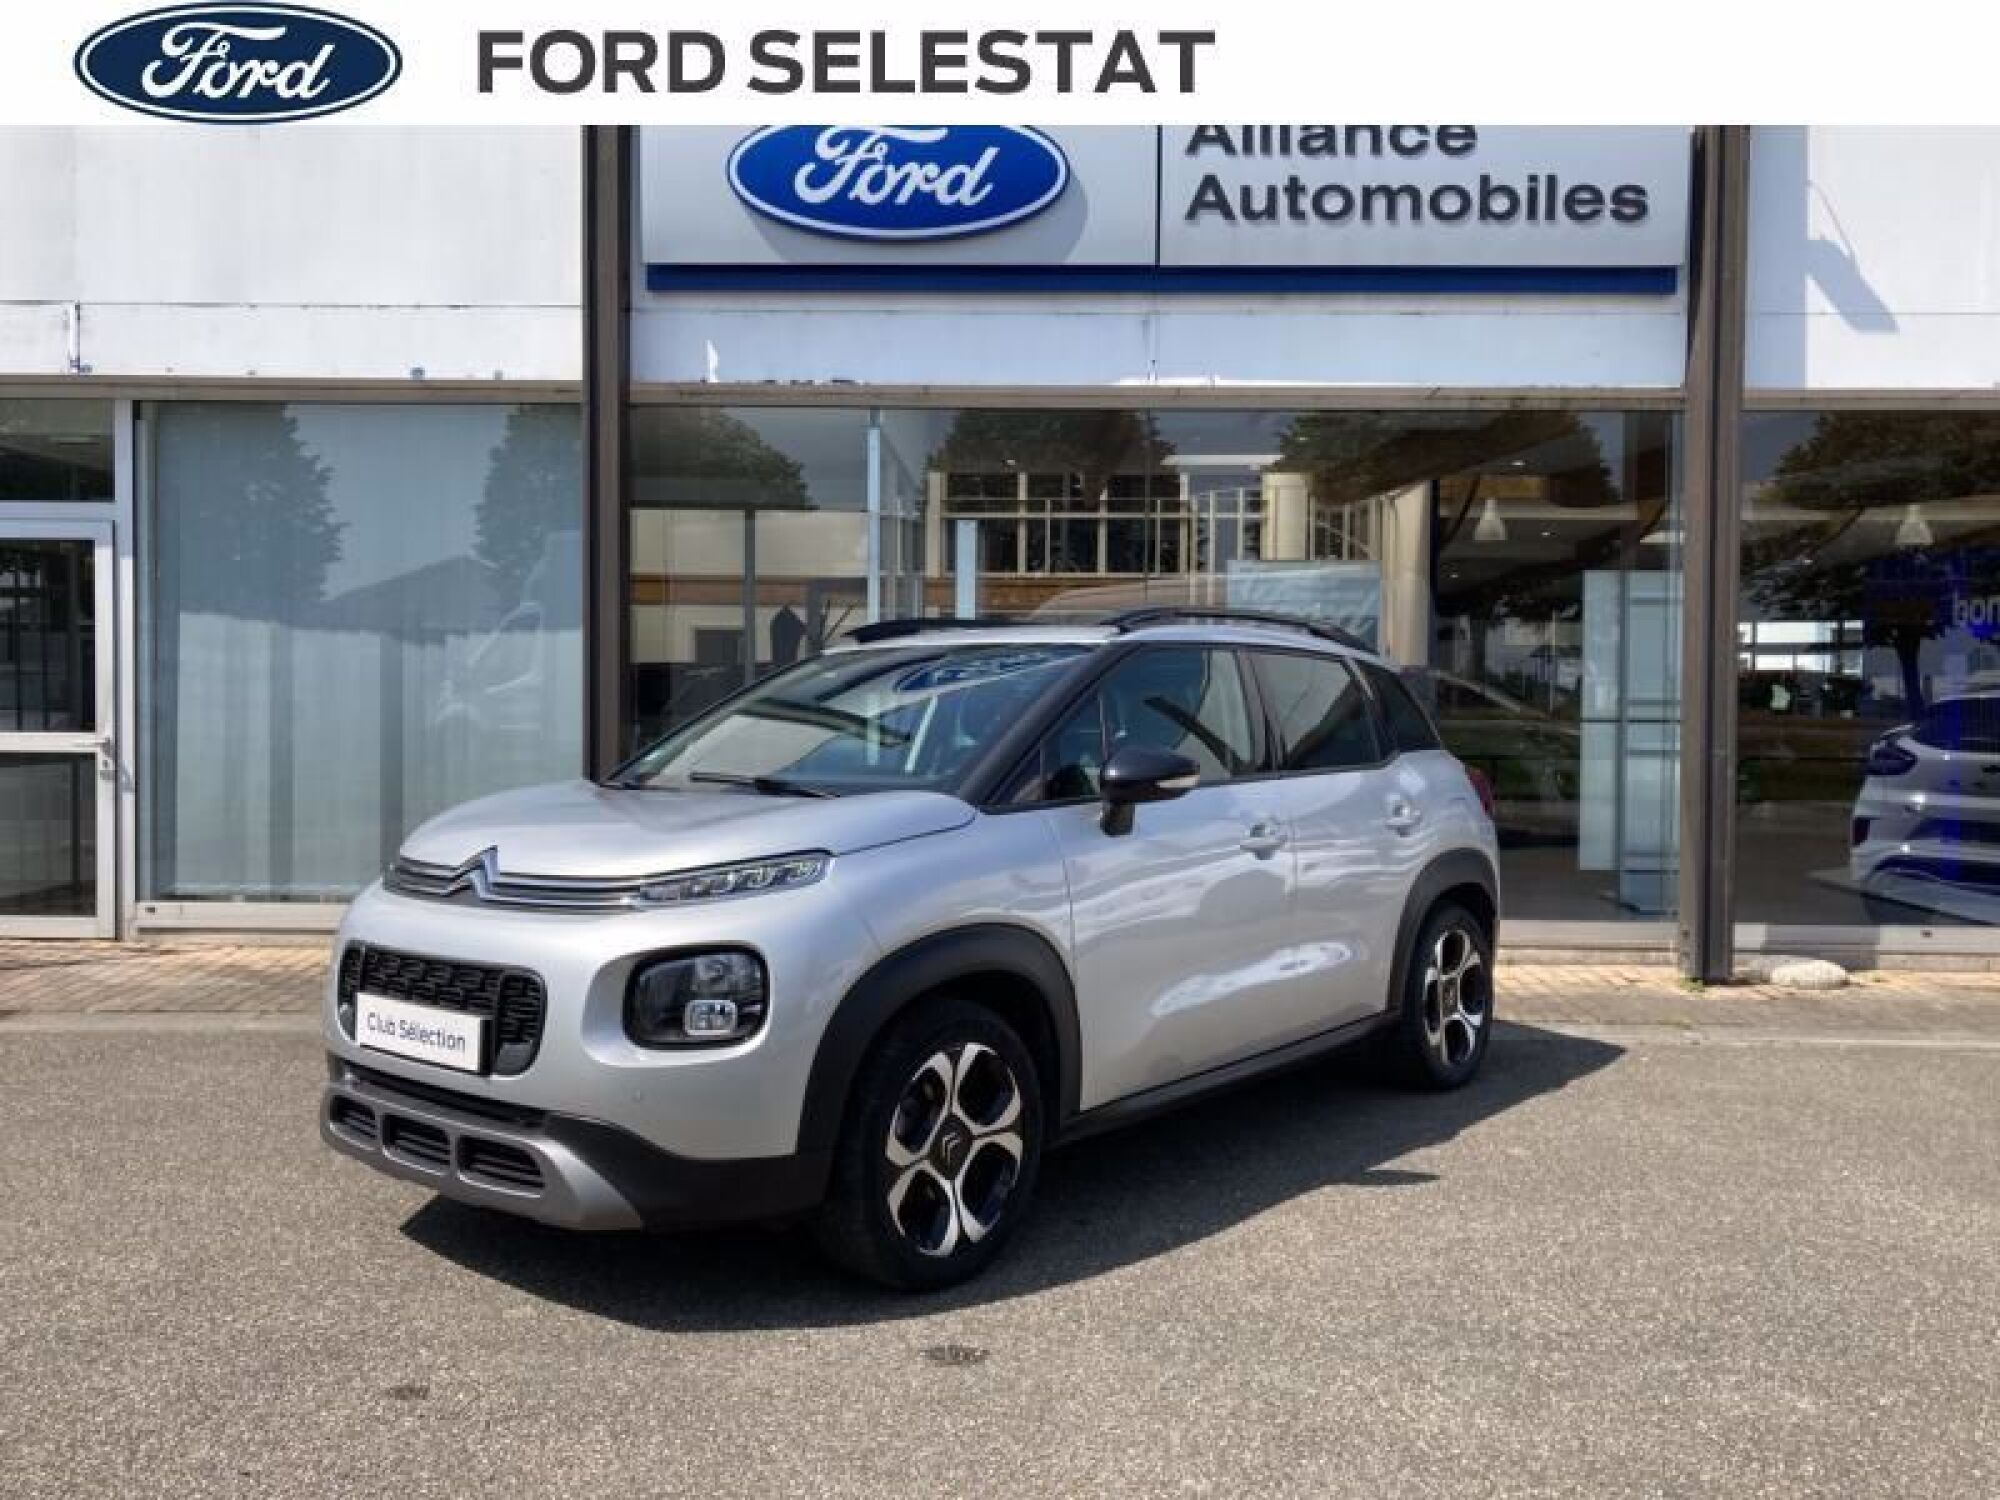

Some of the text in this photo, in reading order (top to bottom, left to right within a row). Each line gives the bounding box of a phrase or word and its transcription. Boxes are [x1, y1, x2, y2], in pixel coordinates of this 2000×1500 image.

[1185, 125, 1477, 157] Alliance
[794, 125, 1001, 206] Ford
[1185, 174, 1650, 223] Automobiles
[366, 1011, 467, 1053] Club Sélection
